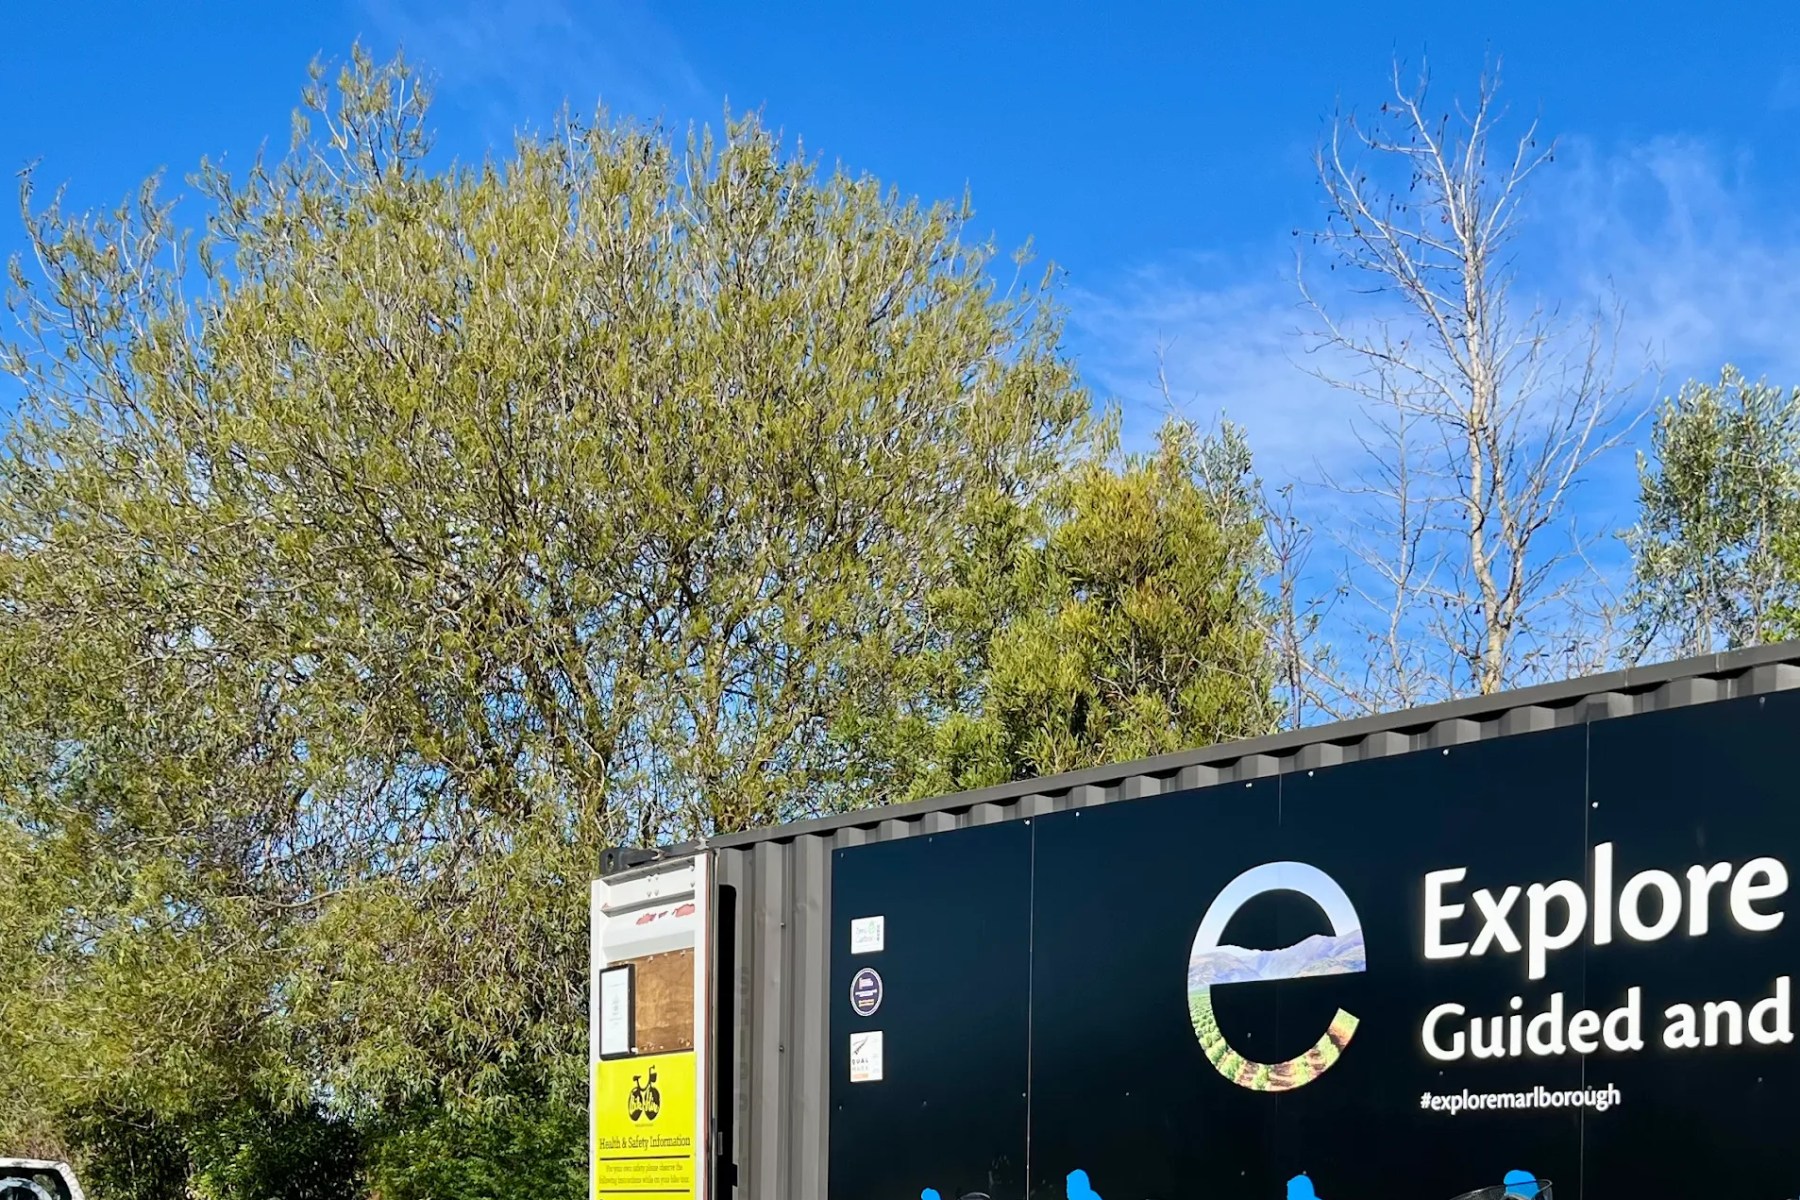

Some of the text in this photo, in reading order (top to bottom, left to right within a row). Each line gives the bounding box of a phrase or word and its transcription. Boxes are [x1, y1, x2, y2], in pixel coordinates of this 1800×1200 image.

[1423, 841, 1789, 980] Explore
[1421, 975, 1795, 1061] Guided and
[1420, 1082, 1622, 1116] #exploremarlborough
[599, 1133, 691, 1151] Health & Safety Information
